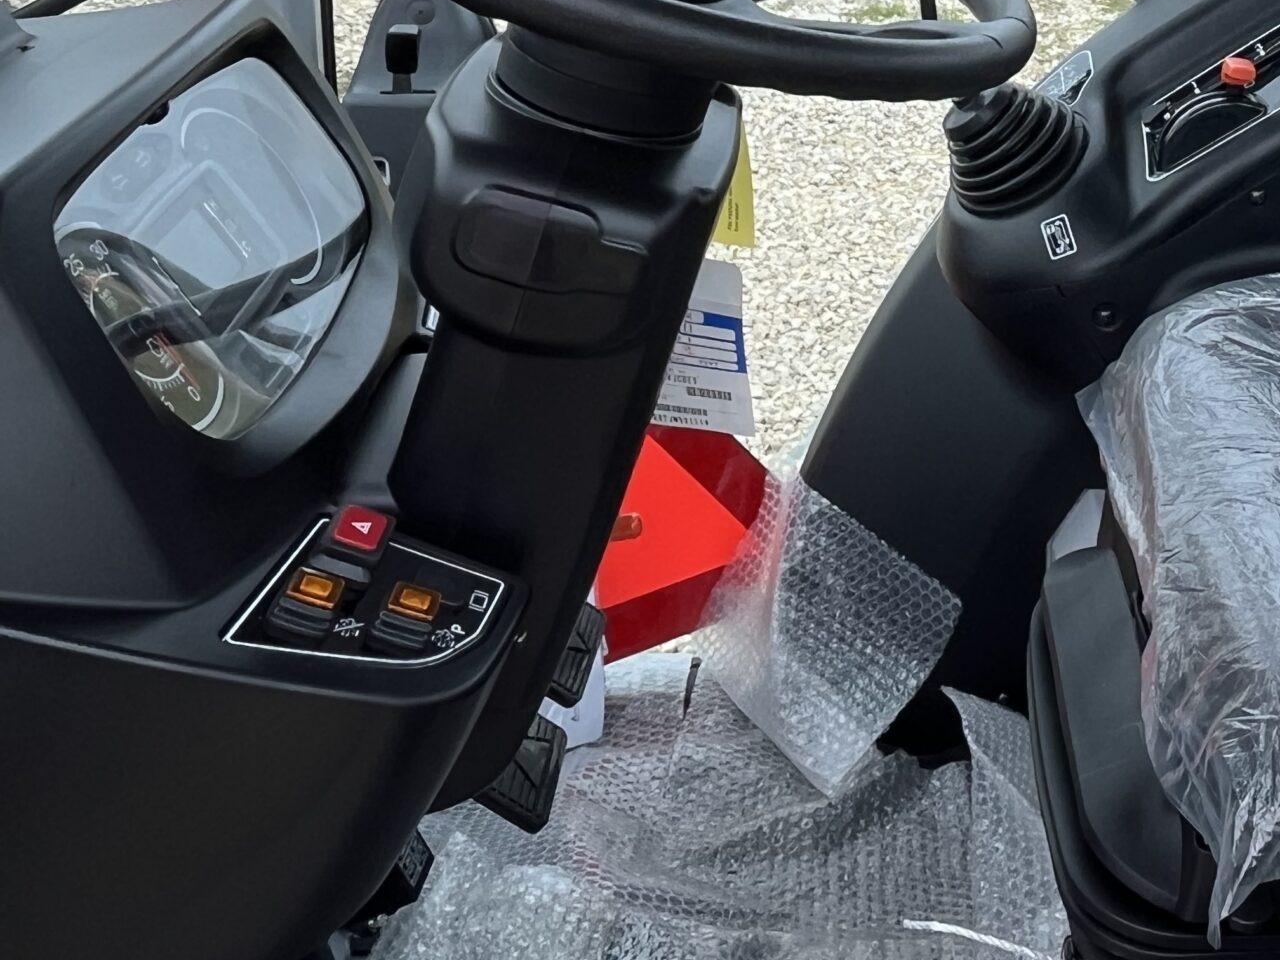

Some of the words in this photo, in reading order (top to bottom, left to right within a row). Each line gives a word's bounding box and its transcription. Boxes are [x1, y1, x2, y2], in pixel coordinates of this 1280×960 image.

[89, 239, 109, 261] 30
[63, 253, 85, 277] 25
[450, 623, 466, 636] P
